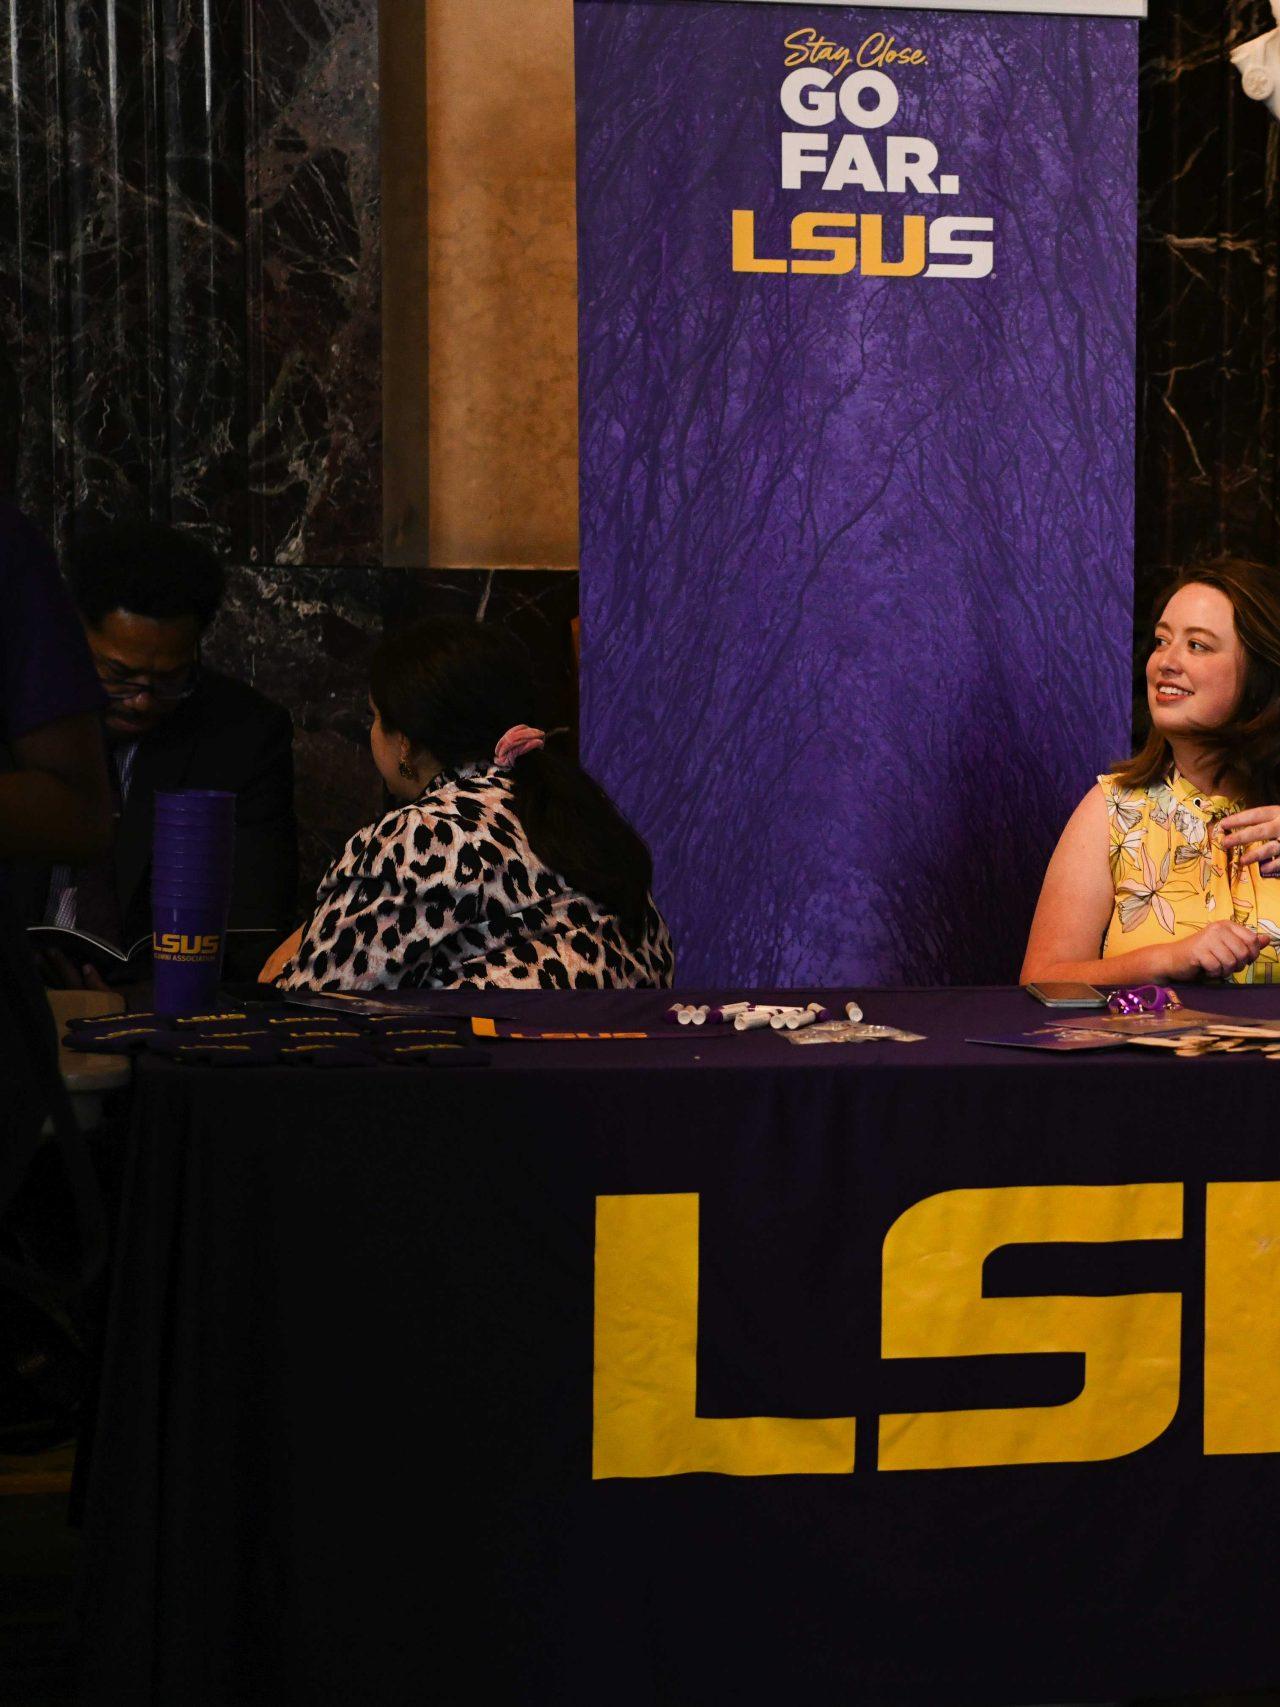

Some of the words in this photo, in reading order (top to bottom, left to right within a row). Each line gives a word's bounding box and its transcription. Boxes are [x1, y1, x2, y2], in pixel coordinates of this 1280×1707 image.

[784, 27, 852, 76] Stay
[857, 32, 929, 67] Close.
[780, 67, 899, 129] GO
[781, 132, 959, 194] FAR.
[732, 209, 994, 278] LSUS
[153, 931, 219, 954] LSUS
